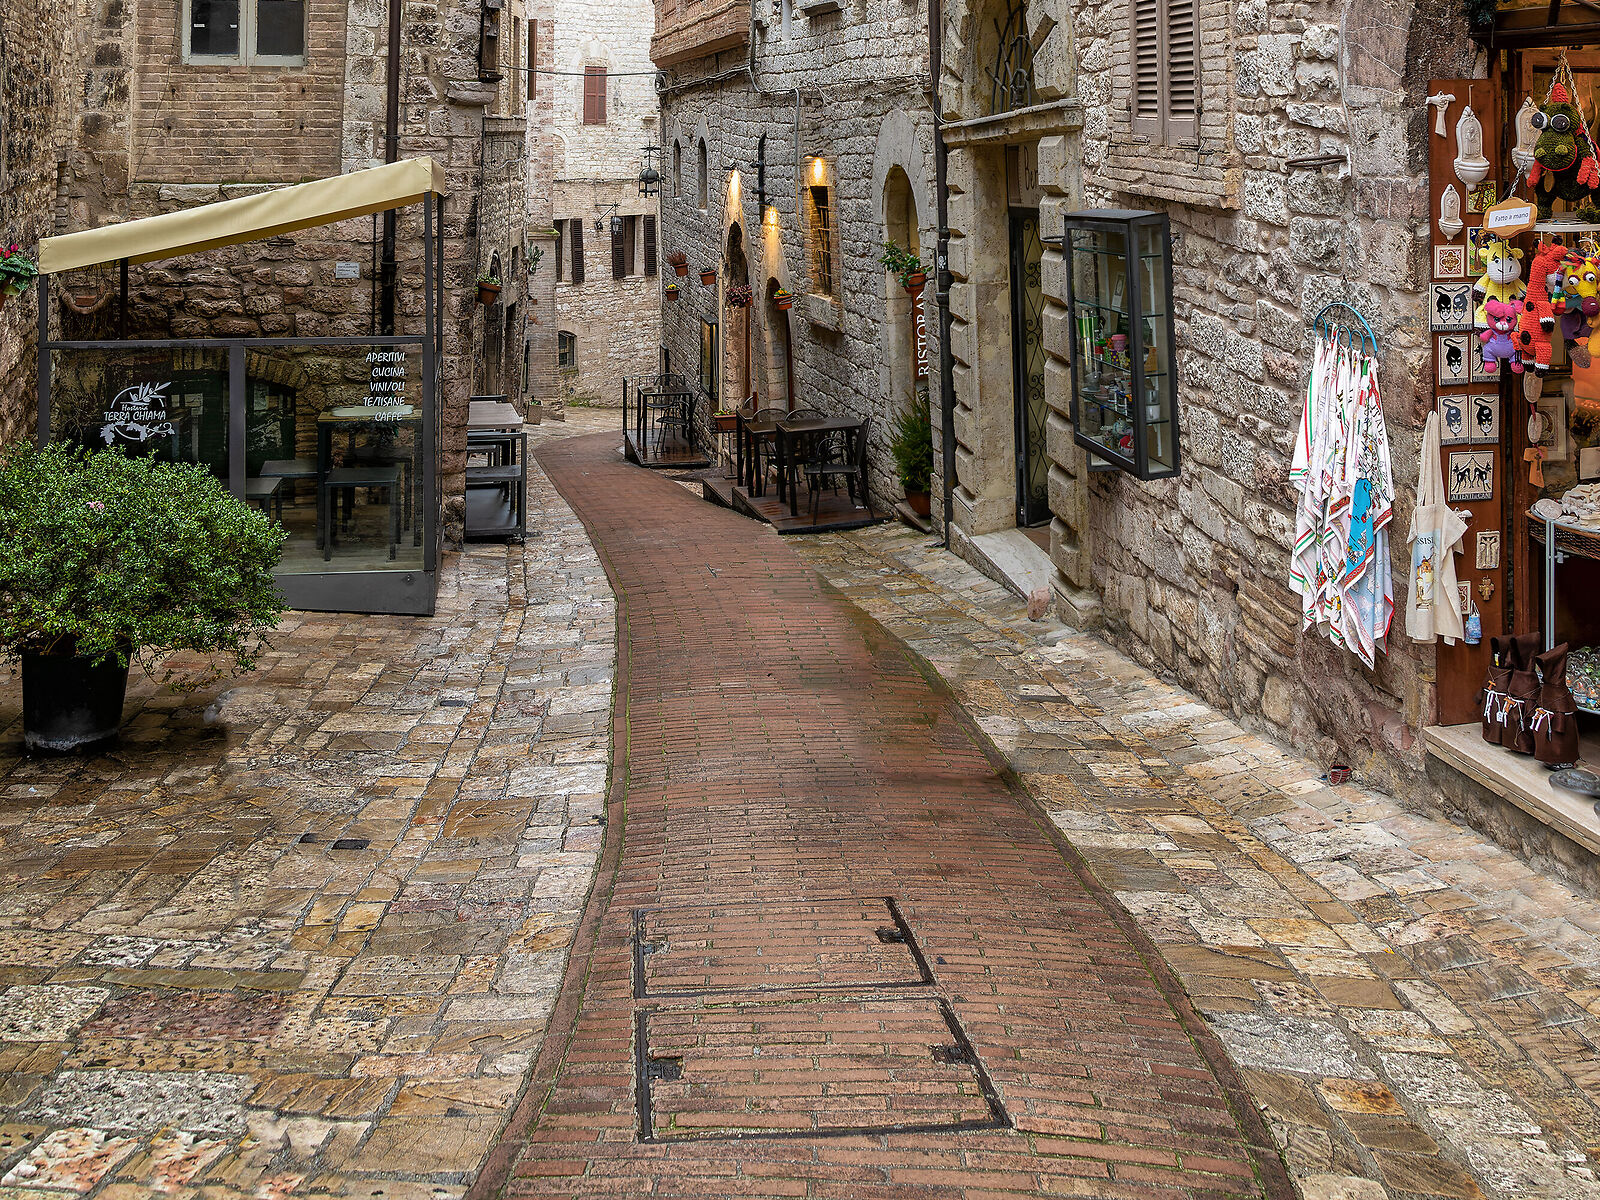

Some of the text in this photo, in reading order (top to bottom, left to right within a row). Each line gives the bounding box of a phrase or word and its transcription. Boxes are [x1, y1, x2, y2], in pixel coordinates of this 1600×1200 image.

[366, 352, 405, 363] APERITIVI
[372, 367, 405, 377] CUCINA
[370, 381, 405, 392] VINI/OLI
[363, 396, 406, 407] TE/TISANE
[104, 410, 166, 421] TERRA CHIAMA
